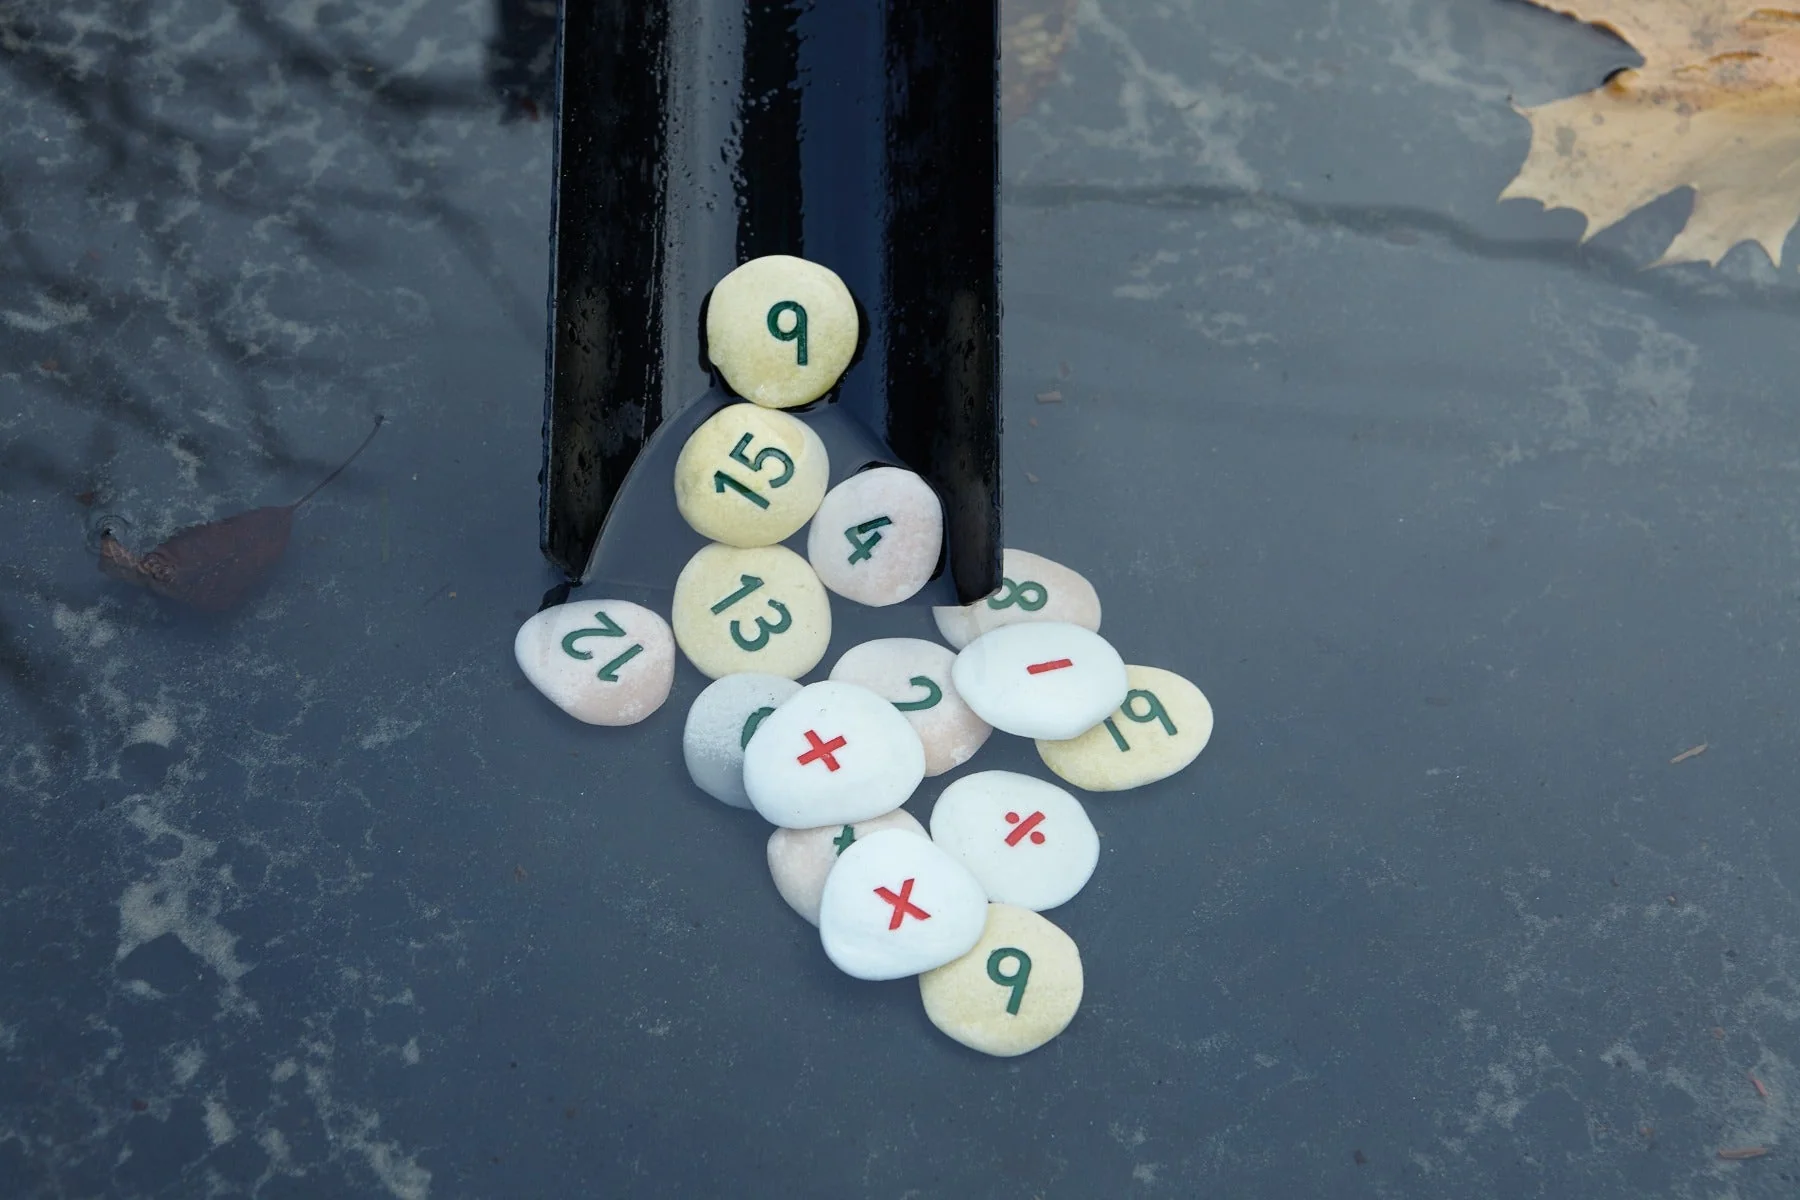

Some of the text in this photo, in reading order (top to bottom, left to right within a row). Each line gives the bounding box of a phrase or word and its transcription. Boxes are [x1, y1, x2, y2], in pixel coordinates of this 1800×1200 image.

[767, 301, 809, 366] 9
[714, 432, 794, 509] 15
[844, 516, 892, 565] 4
[711, 574, 792, 652] 13
[987, 578, 1048, 611] 8
[562, 611, 643, 682] 12
[1103, 689, 1178, 752] 19
[987, 947, 1032, 1016] 9
